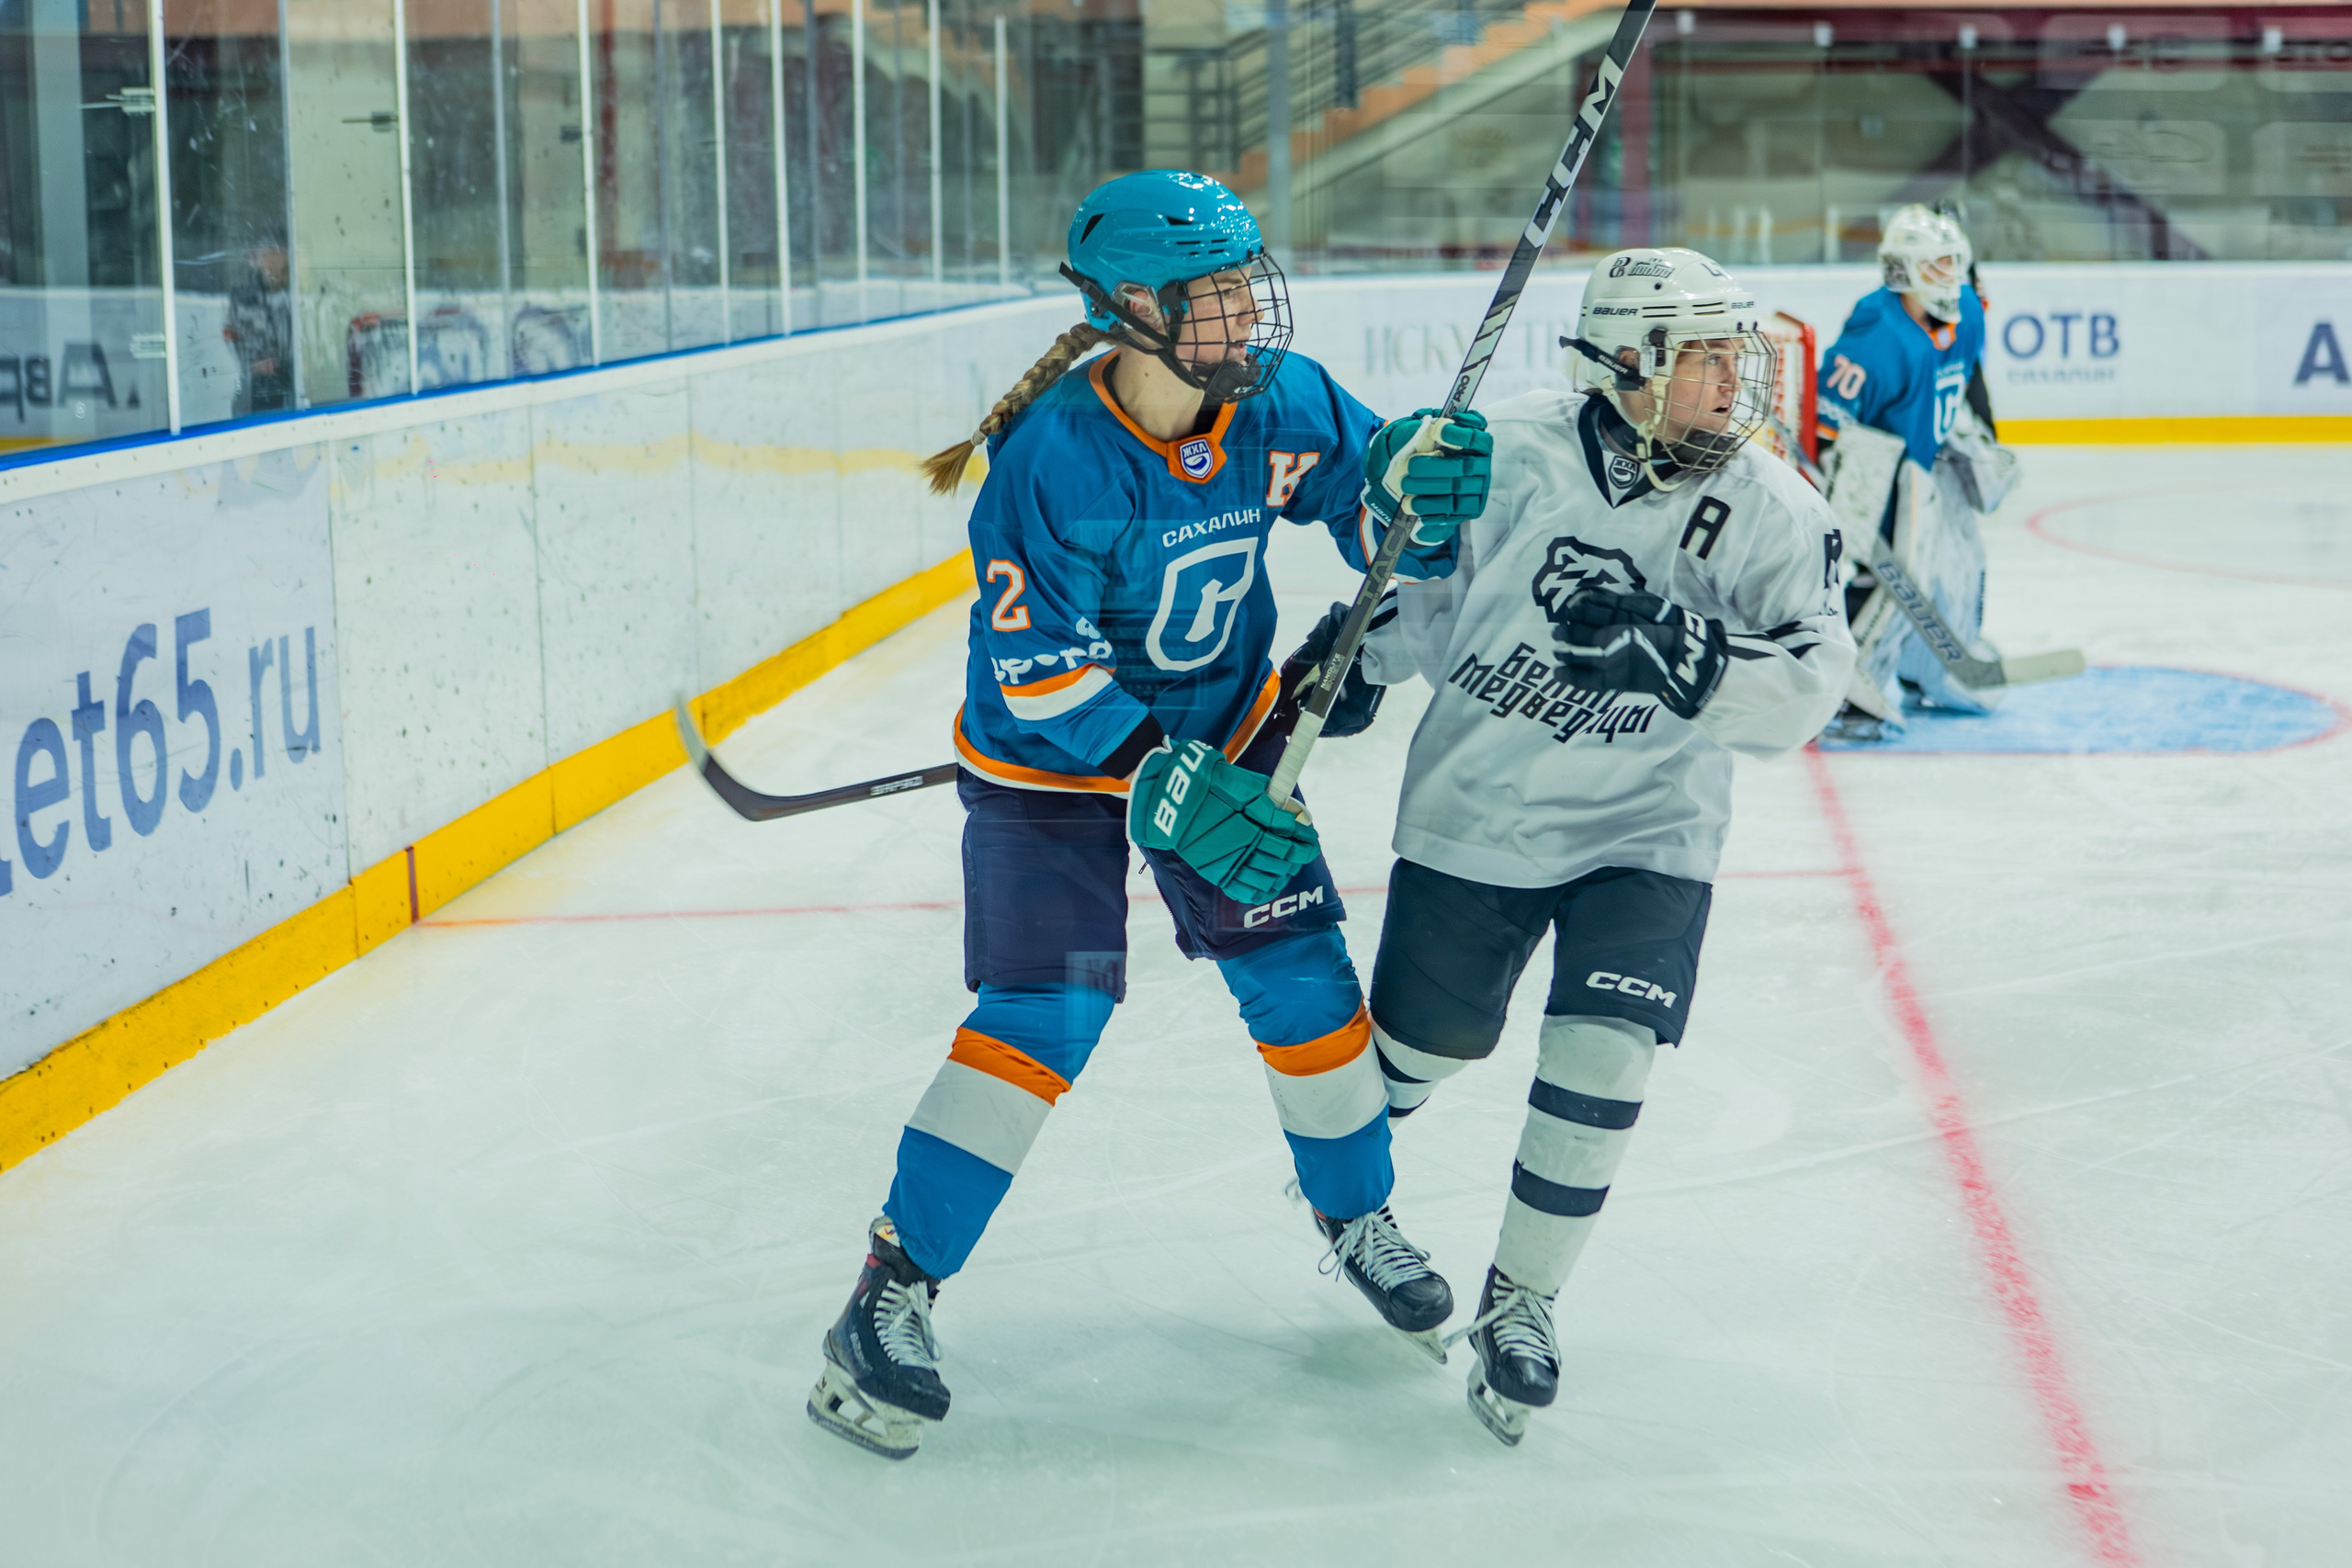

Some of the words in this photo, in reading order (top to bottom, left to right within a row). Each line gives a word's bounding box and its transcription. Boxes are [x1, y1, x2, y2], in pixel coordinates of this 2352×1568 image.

[1592, 306, 1639, 317] BAUER
[1453, 375, 1470, 404] PRO
[1826, 354, 1866, 400] 70
[1182, 442, 1207, 458] ЖХЛ
[1161, 508, 1261, 548] САХАЛИН
[987, 558, 1031, 632] 2
[1877, 560, 1962, 662] BAUER
[0, 607, 321, 897] et65.ru
[1243, 885, 1324, 930] CCM
[1585, 970, 1678, 1009] CCM
